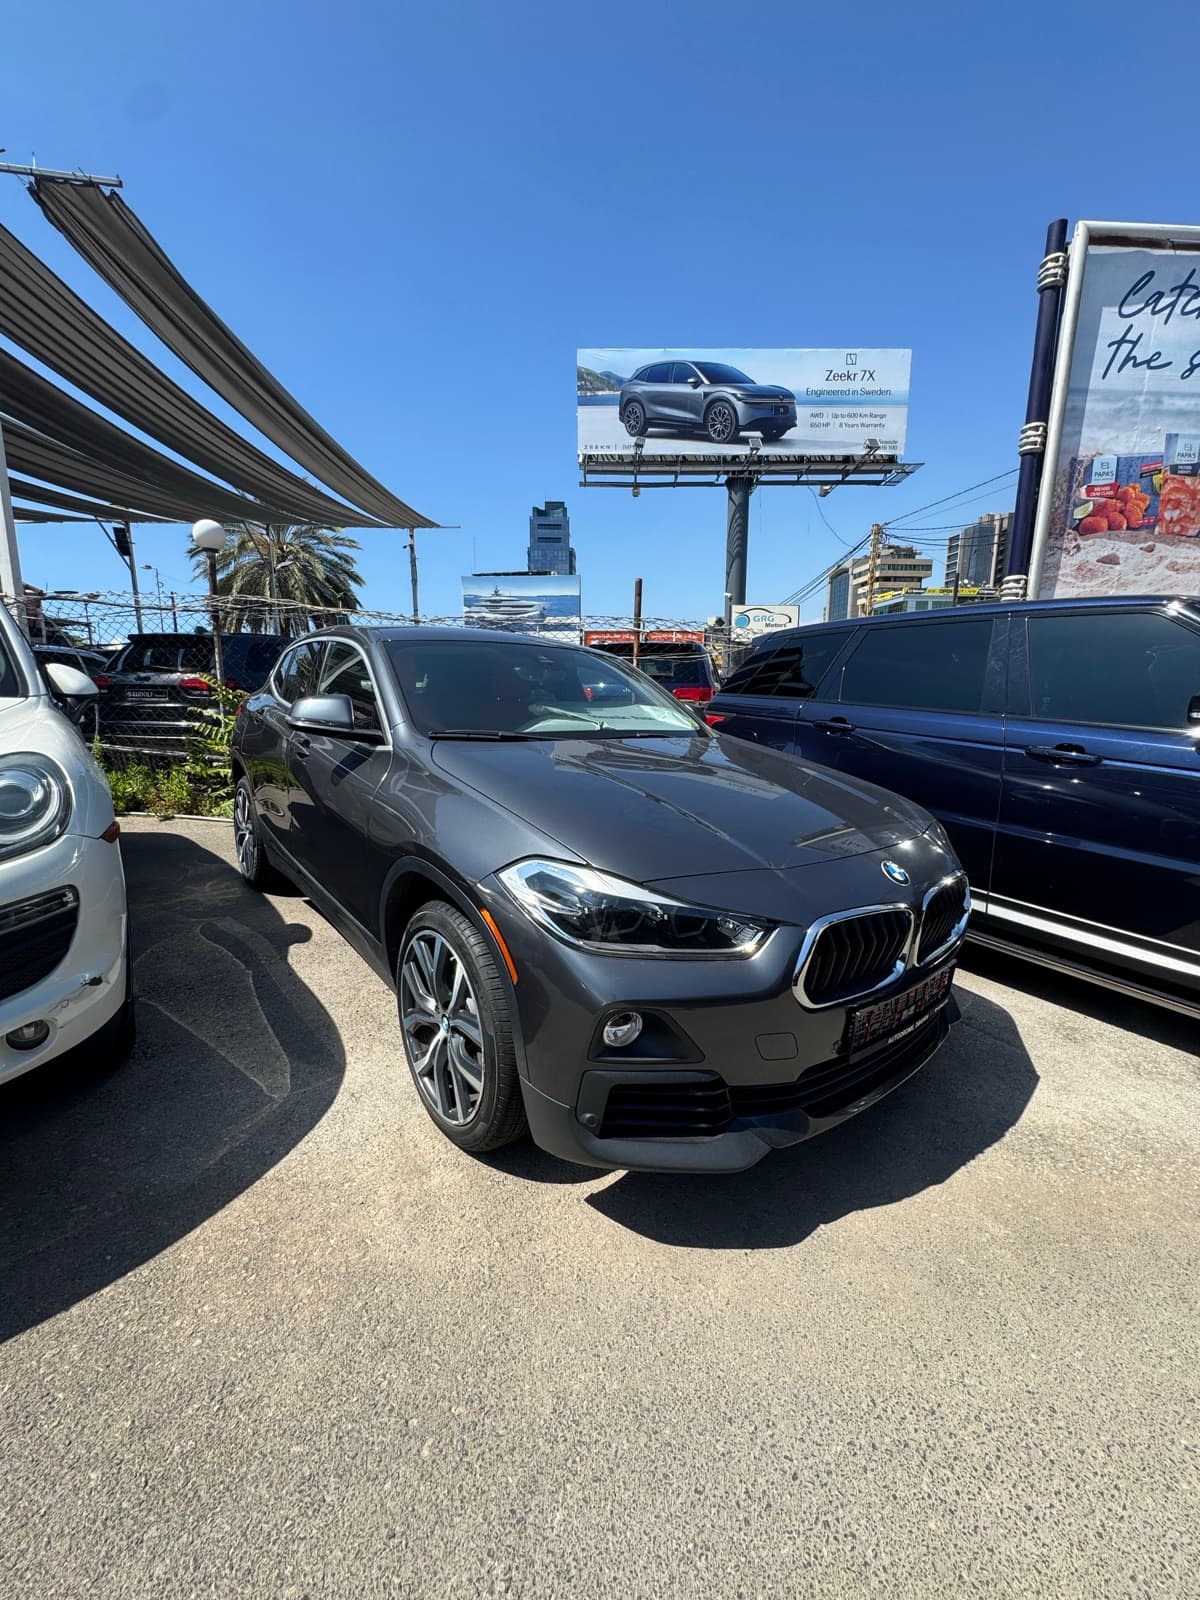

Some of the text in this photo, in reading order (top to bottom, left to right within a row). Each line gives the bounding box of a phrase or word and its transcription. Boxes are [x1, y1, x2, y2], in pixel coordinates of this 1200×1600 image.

[1118, 267, 1200, 326] Catc
[1102, 323, 1173, 380] the
[825, 369, 876, 382] Zeekr 7X
[806, 387, 851, 397] Engineered
[851, 387, 859, 396] in
[831, 412, 840, 420] Up
[869, 412, 887, 420] Range
[860, 422, 886, 430] Warranty
